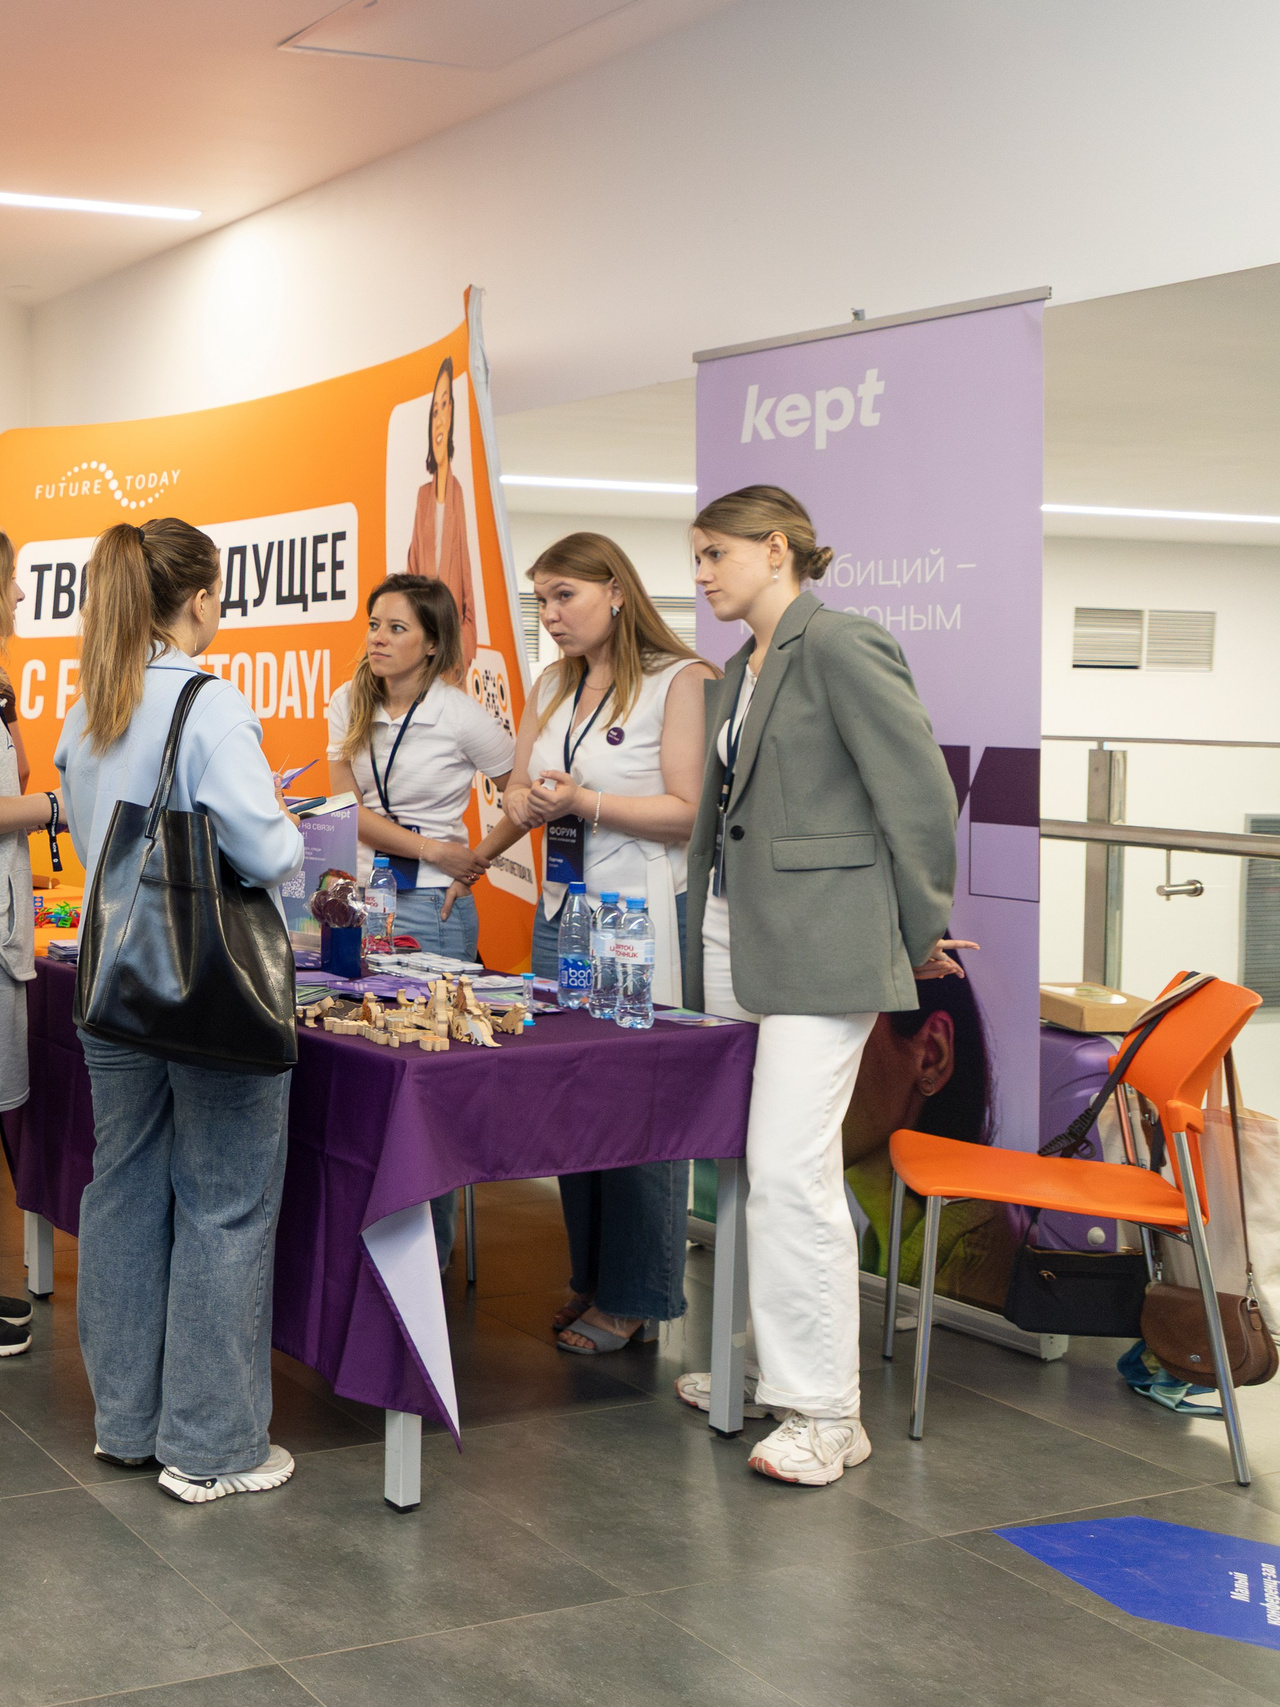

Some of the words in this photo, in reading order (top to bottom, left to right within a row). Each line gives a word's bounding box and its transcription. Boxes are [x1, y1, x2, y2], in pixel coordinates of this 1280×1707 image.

[740, 368, 885, 450] kept
[35, 479, 102, 499] FUTURE
[125, 469, 181, 491] TODAY
[218, 531, 347, 618] ДУЩЕЕ
[549, 826, 577, 838] ФОРУМ
[1228, 1571, 1250, 1603] Малый
